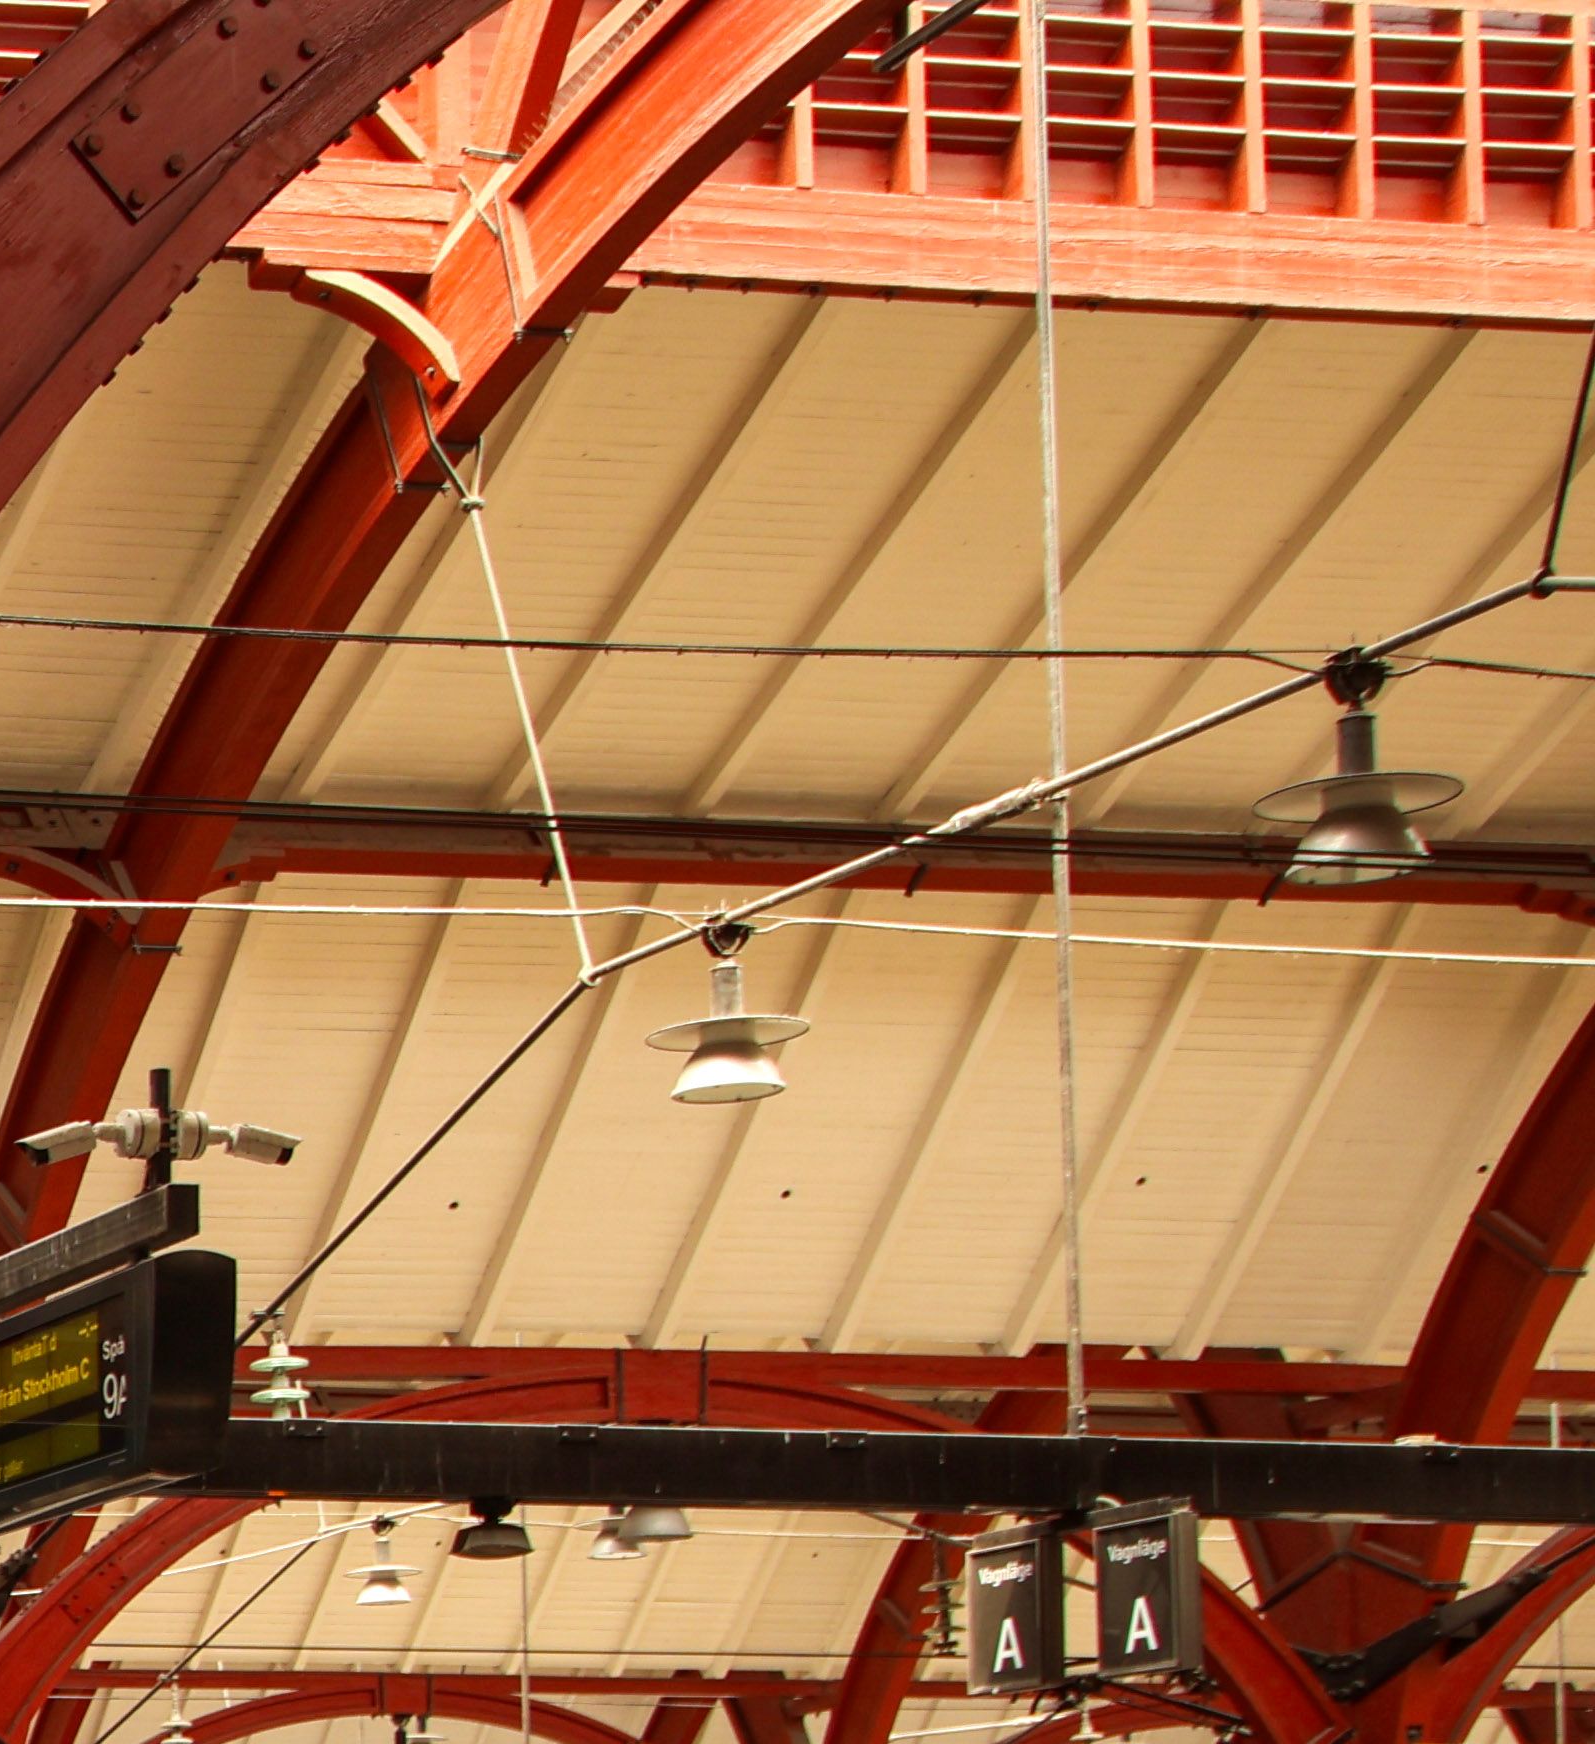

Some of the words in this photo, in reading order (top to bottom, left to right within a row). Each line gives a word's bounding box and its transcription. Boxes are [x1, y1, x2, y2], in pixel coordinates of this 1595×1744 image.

[22, 1363, 80, 1401] Stockholm
[80, 1357, 90, 1379] C
[993, 1617, 1024, 1673] A
[1125, 1596, 1159, 1654] A
